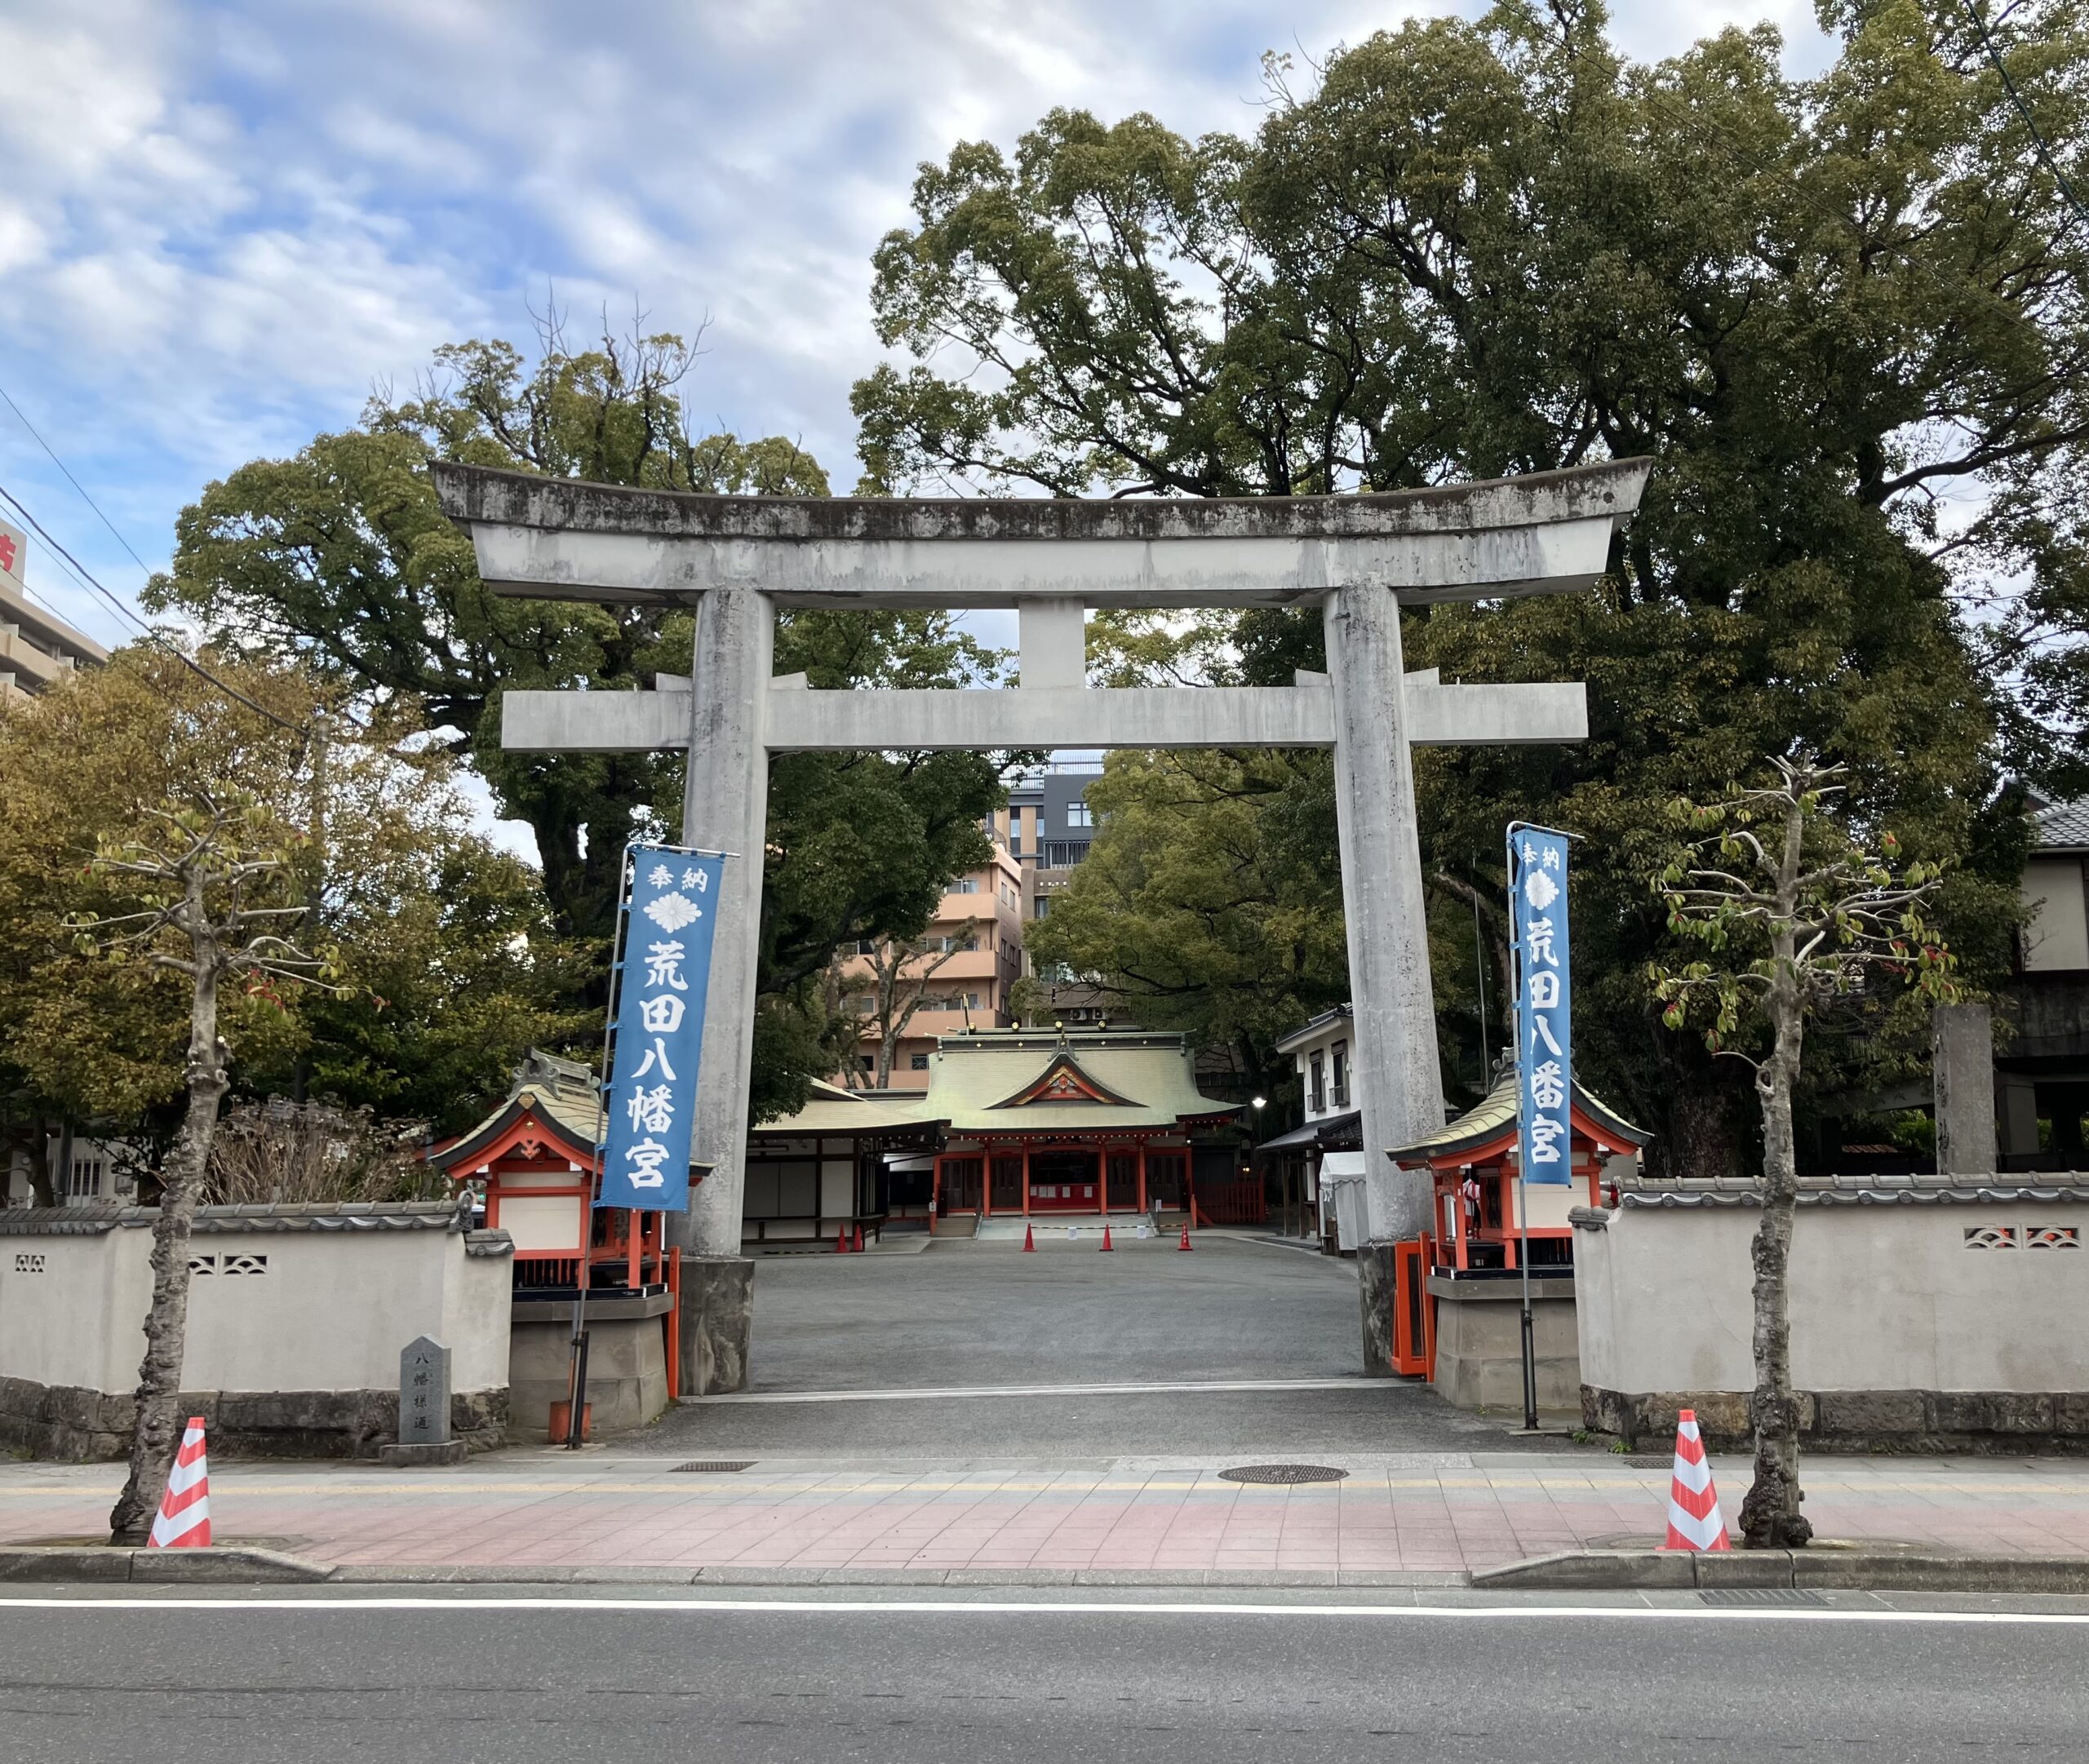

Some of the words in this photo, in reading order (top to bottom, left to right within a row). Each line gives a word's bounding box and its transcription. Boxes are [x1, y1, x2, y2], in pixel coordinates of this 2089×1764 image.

[1521, 841, 1559, 871] 奉納
[647, 864, 709, 893] 奉納
[624, 939, 690, 1190] 荒田八幡宮
